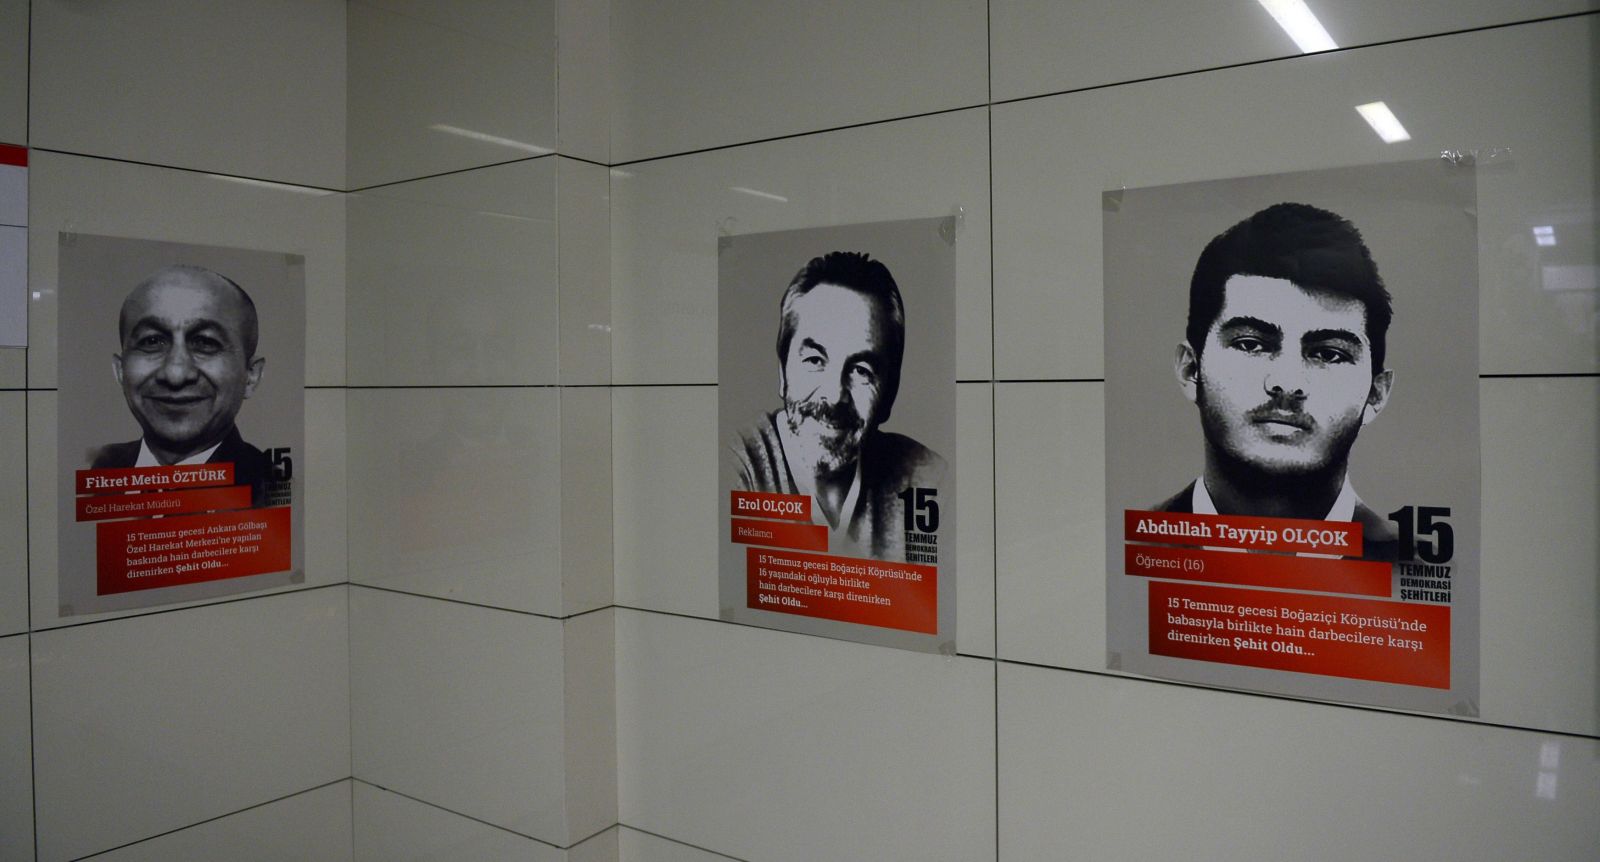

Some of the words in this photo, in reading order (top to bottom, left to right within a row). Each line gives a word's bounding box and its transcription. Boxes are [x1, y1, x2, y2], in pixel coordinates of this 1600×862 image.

[263, 447, 292, 482] 15
[85, 476, 128, 488] Fikret
[131, 473, 170, 486] Metin
[172, 469, 226, 483] ÖZTÜRK
[85, 503, 107, 514] Özel
[108, 501, 145, 512] Harekat
[147, 499, 181, 510] Müdürü
[738, 497, 760, 511] Erol
[764, 499, 804, 515] OLÇOK
[898, 487, 939, 533] 15
[127, 534, 136, 542] 15
[139, 531, 177, 541] Temmuz
[178, 527, 205, 539] gecesi
[207, 524, 237, 534] Ankara
[238, 521, 268, 532] Gölbaşı
[738, 526, 774, 539] Reklamcı
[904, 532, 937, 544] TEMMUZ
[1136, 518, 1212, 538] Abdullah
[1216, 523, 1278, 544] Tayyip
[1282, 527, 1349, 548] OLÇOK
[1388, 506, 1454, 564] 15
[127, 544, 147, 554] Özel
[149, 541, 184, 552] Harekat
[185, 536, 231, 549] Merkezi'ne
[232, 532, 262, 545] yapılan
[127, 554, 168, 566] baskında
[170, 552, 189, 561] hain
[191, 547, 237, 559] darbecilere
[239, 544, 259, 554] karşı
[1136, 552, 1180, 570] Öğrenci
[1183, 558, 1204, 572] (16)
[127, 566, 174, 579] direnirken
[176, 562, 200, 574] Şehit
[759, 554, 767, 563] 15
[768, 555, 801, 568] Temmuz
[802, 560, 829, 571] gecesi
[830, 562, 866, 576] Boğaziçi
[868, 565, 923, 582] Köprüsü'nde
[759, 568, 767, 577] 16
[768, 569, 806, 583] yaşındaki
[807, 573, 837, 586] oğluyla
[839, 576, 870, 589] birlikte
[1399, 563, 1451, 579] TEMMUZ
[759, 580, 776, 591] hain
[778, 582, 822, 597] darbecilere
[824, 588, 845, 600] karşı
[846, 591, 891, 606] direnirken
[1400, 578, 1451, 590] DEMOKRASİ
[759, 593, 780, 605] Şehit
[1400, 589, 1451, 603] ŞEHİTLERİ
[1167, 597, 1179, 608] 15
[1182, 597, 1234, 614] Temmuz
[1237, 604, 1278, 619] gecesi
[1281, 607, 1337, 625] Boğaziçi
[1341, 612, 1428, 633] Köprüsü'nde
[1167, 613, 1224, 630] babasıyla
[1227, 618, 1273, 634] birlikte
[1276, 623, 1305, 638] hain
[1308, 626, 1384, 646] darbecilere
[1388, 634, 1424, 650] karşı
[1167, 630, 1231, 647] direnirken
[1234, 636, 1268, 653] Şehit
[1271, 640, 1316, 657] Oldu...
